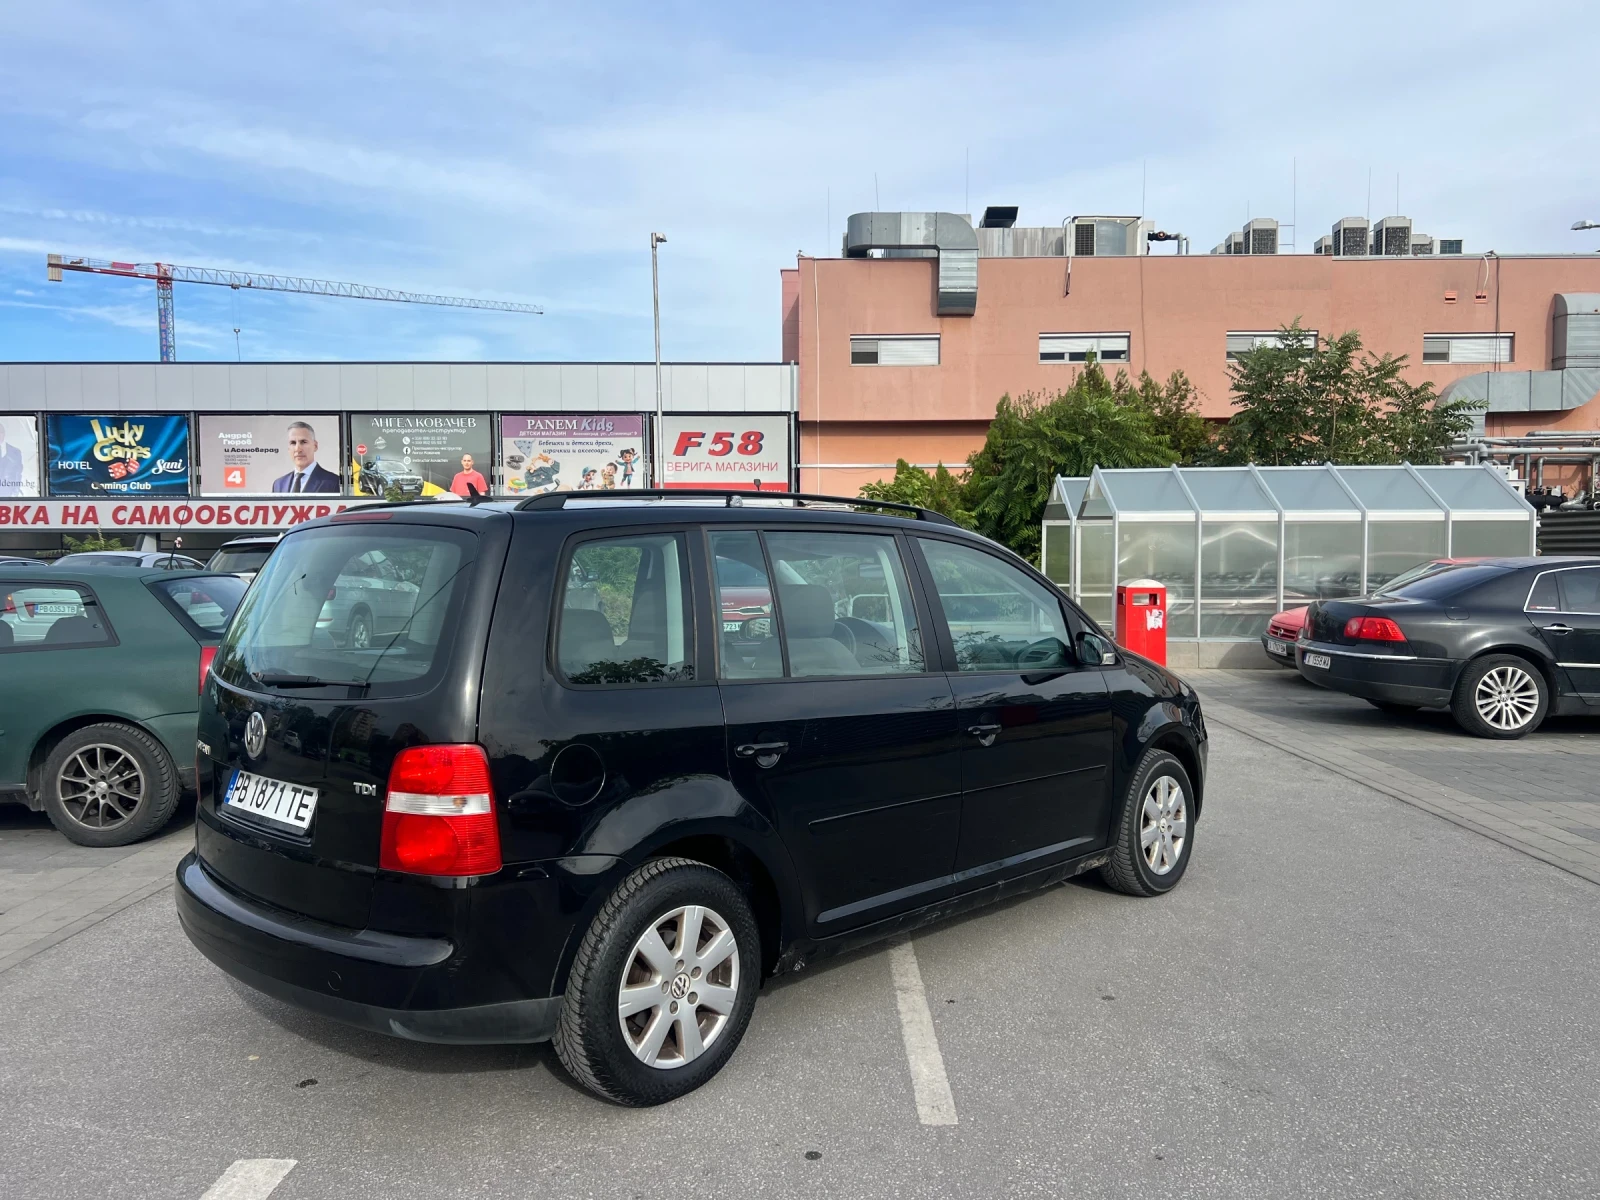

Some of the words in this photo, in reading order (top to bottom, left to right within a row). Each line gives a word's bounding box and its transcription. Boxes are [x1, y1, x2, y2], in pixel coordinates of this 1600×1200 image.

[371, 417, 412, 428] АНГЕЛ
[416, 417, 477, 428] КОВАЧЕВ
[527, 419, 578, 430] PANEM
[580, 418, 615, 432] Kids
[90, 419, 144, 446] Lucky
[223, 438, 252, 446] Гюров
[672, 431, 765, 456] F58
[93, 438, 151, 462] Games
[58, 461, 92, 470] HOTEL
[152, 459, 186, 475] Sani
[667, 462, 712, 472] ВЕРИГА
[716, 462, 778, 472] МАГАЗИНИ
[227, 470, 242, 484] 4
[129, 481, 152, 490] Club
[61, 505, 100, 525] НА
[231, 772, 251, 803] PB
[249, 777, 287, 815] 1871
[286, 786, 314, 822] TE
